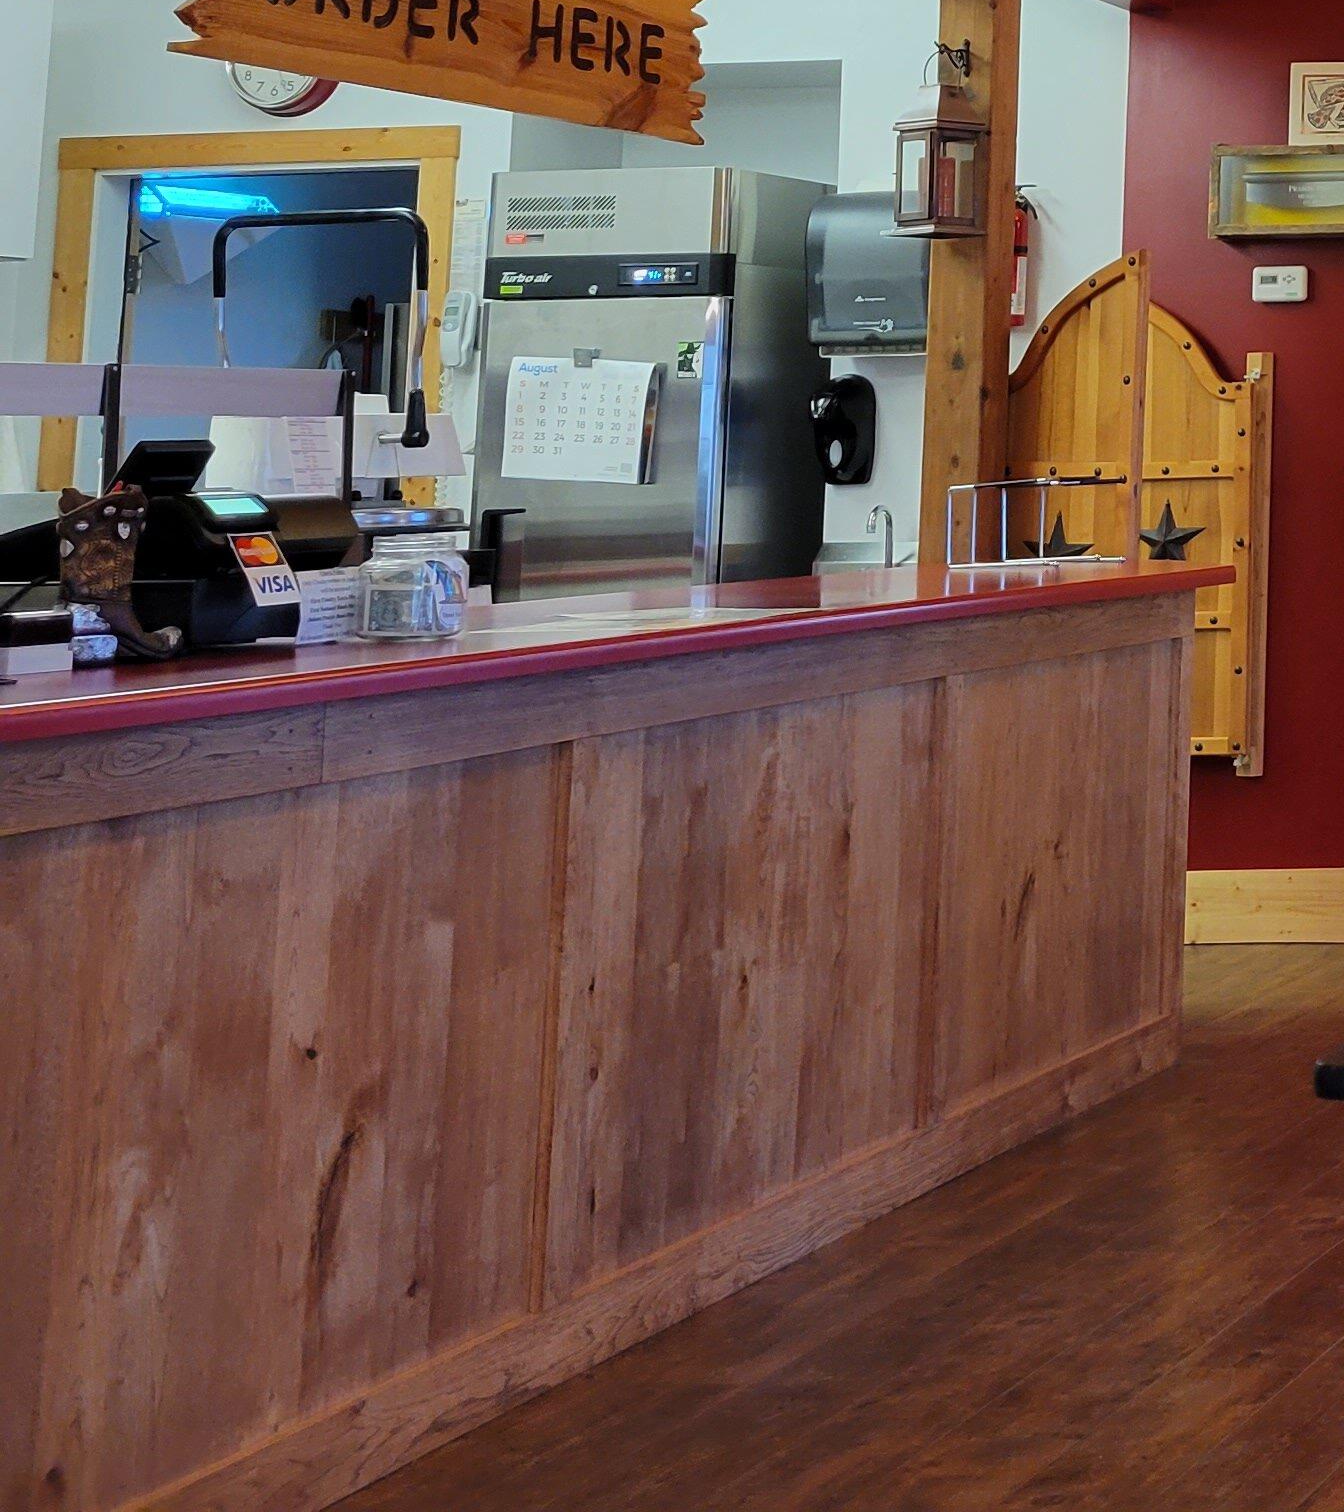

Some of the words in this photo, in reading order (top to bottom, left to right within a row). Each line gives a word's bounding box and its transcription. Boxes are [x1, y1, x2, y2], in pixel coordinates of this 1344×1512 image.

[500, 271, 535, 284] Turbo
[534, 272, 553, 284] air
[518, 362, 558, 376] August
[519, 379, 527, 388] S
[539, 380, 549, 388] M
[563, 381, 570, 389] T
[580, 382, 591, 390] W
[601, 383, 607, 391] T
[617, 383, 623, 392] F
[633, 384, 640, 393] S
[539, 391, 546, 400] 2
[561, 392, 567, 401] 3
[580, 393, 587, 402] 4
[599, 394, 605, 403] 5
[615, 395, 621, 404] 6
[516, 404, 524, 413] 8
[539, 405, 546, 414] 9
[557, 405, 568, 414] 10
[578, 406, 586, 416] 11
[613, 408, 621, 418] 13
[514, 417, 525, 426] 15
[536, 418, 546, 427] 16
[557, 419, 566, 428] 17
[576, 420, 586, 429] 18
[594, 420, 604, 430] 19
[610, 421, 621, 431] 20
[511, 431, 524, 440] 22
[533, 432, 546, 441] 23
[553, 433, 565, 442] 24
[573, 433, 585, 443] 25
[609, 436, 620, 445] 27
[511, 444, 524, 454] 29
[531, 445, 545, 454] 30
[551, 446, 562, 456] 31
[256, 574, 295, 594] VISA
